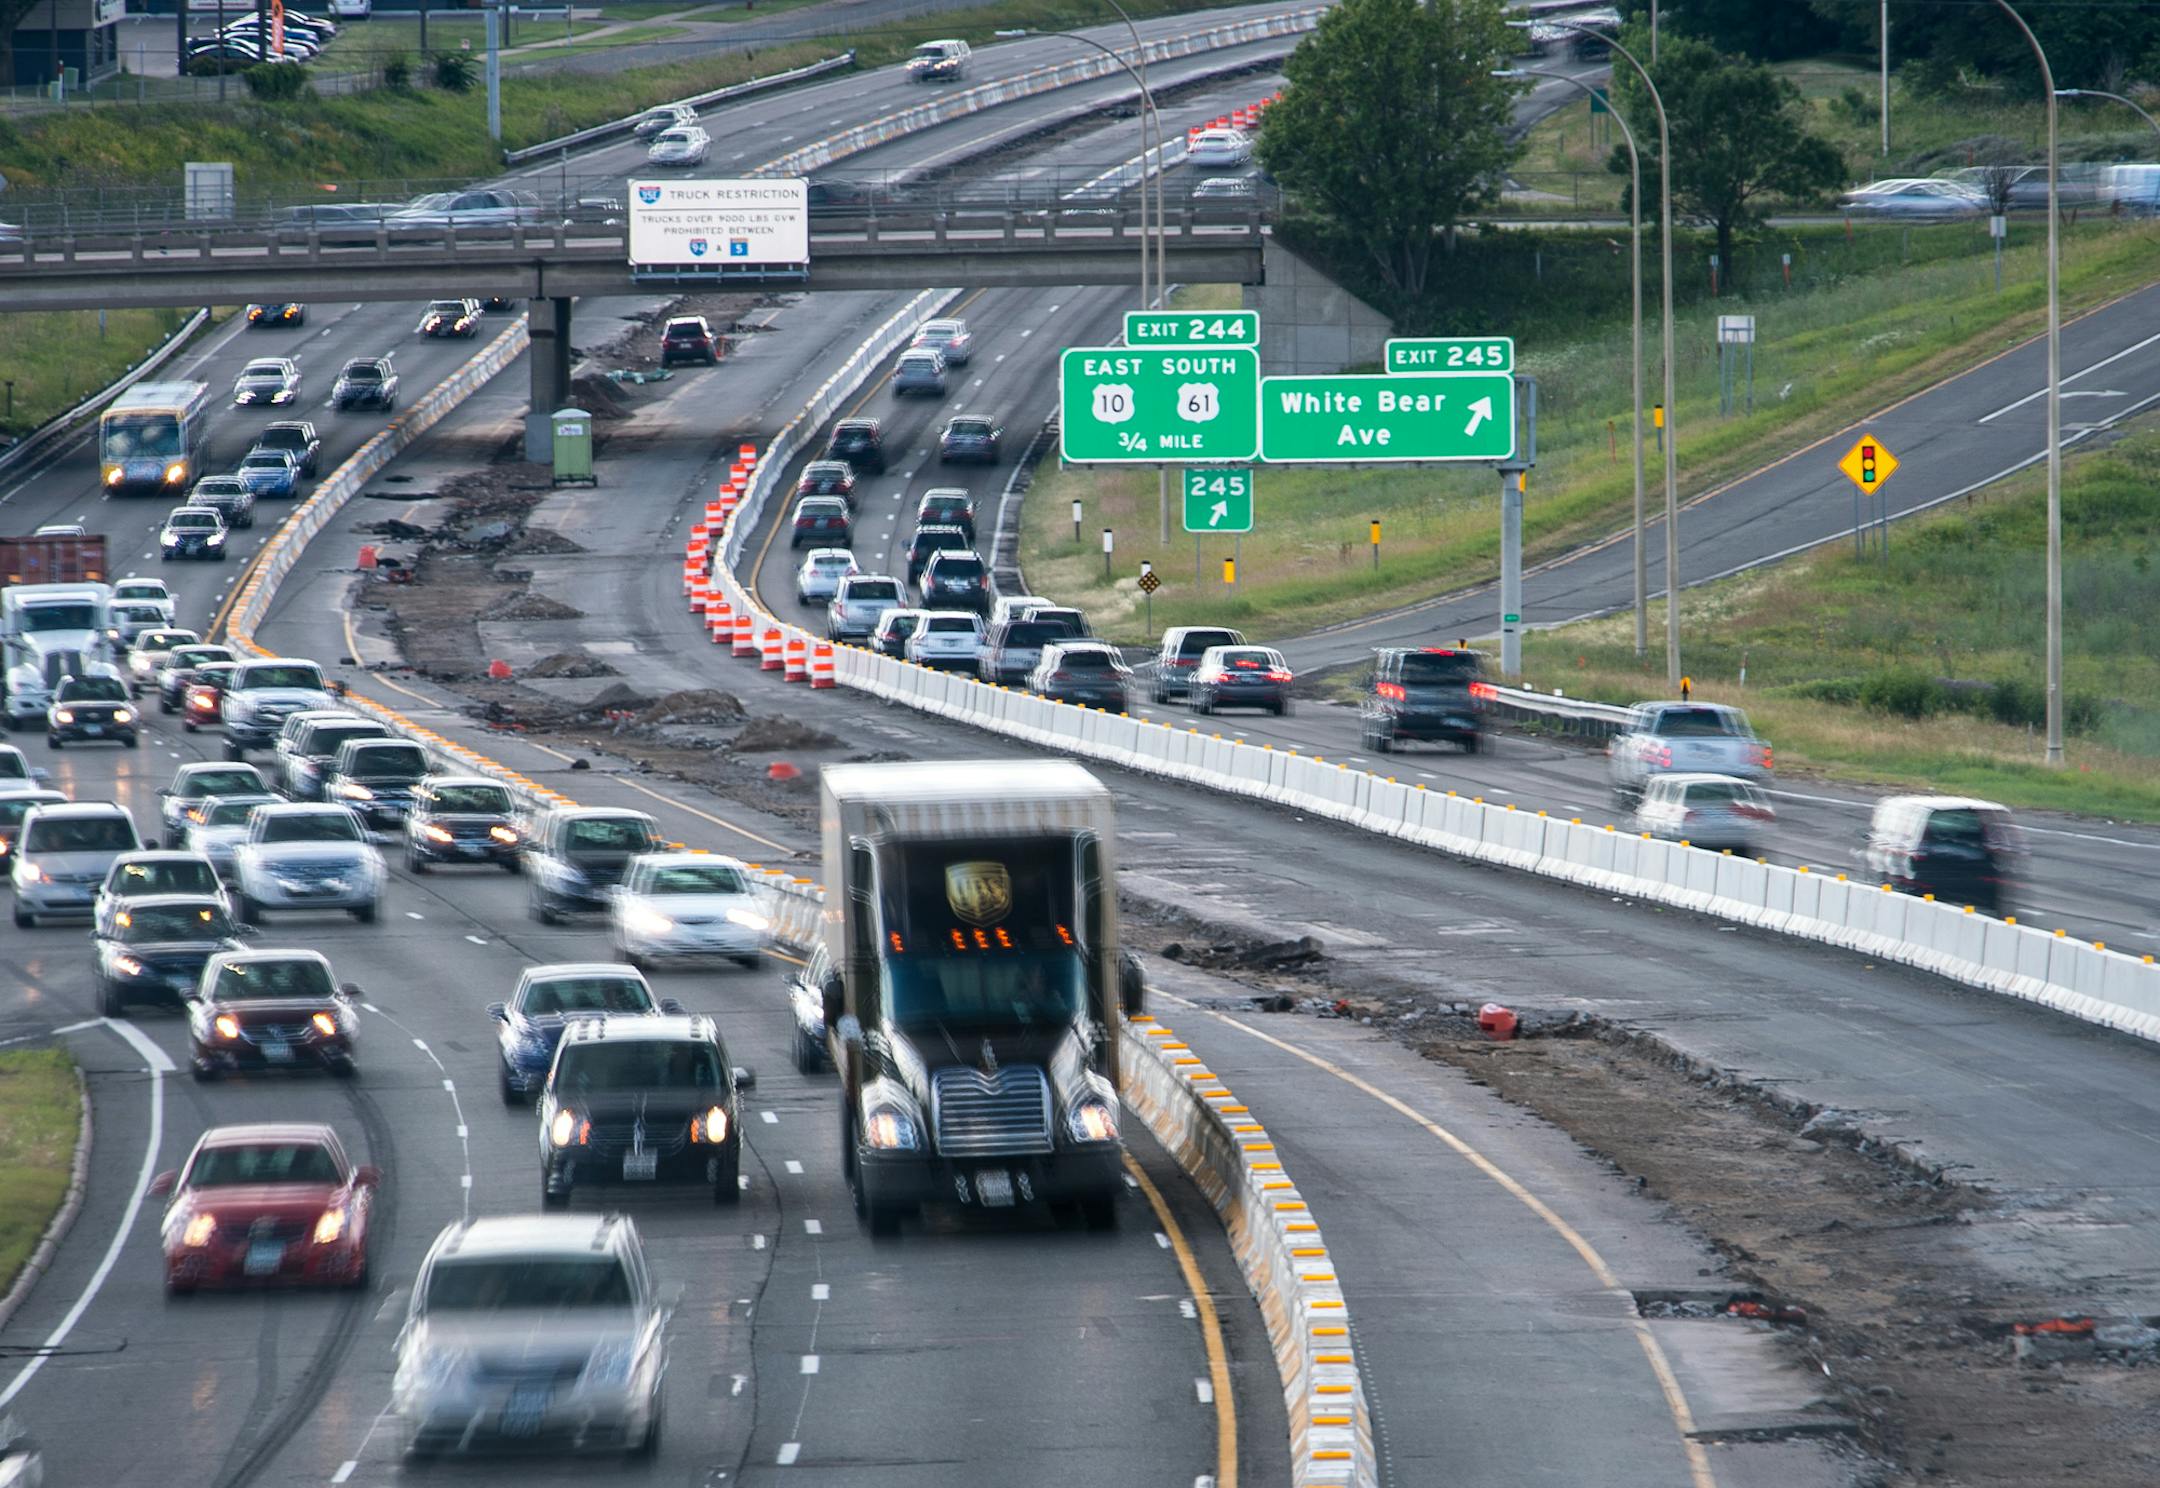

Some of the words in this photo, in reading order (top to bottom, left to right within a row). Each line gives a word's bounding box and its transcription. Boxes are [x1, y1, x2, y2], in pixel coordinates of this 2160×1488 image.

[670, 190, 711, 200] TRUCK
[717, 189, 800, 199] RESTRICTION
[642, 215, 682, 223] TRUCKS
[687, 215, 713, 223] OVER
[750, 214, 769, 222] LBS
[664, 227, 724, 235] PROHIBITED
[729, 226, 775, 234] BETWEEN
[691, 242, 706, 253] 94
[735, 243, 743, 254] 5
[1137, 322, 1179, 338] EXIT
[1188, 318, 1247, 340] 244
[1395, 349, 1438, 365] EXIT
[1447, 345, 1505, 367] 245
[1083, 358, 1144, 376] EAST
[1161, 357, 1237, 376] SOUTH
[1101, 394, 1125, 413] 10
[1187, 394, 1210, 413] 61
[1280, 391, 1363, 414] White
[1377, 389, 1447, 413] Bear
[1159, 434, 1204, 449] MILE
[1336, 423, 1392, 446] Ave
[1190, 476, 1245, 496] 245
